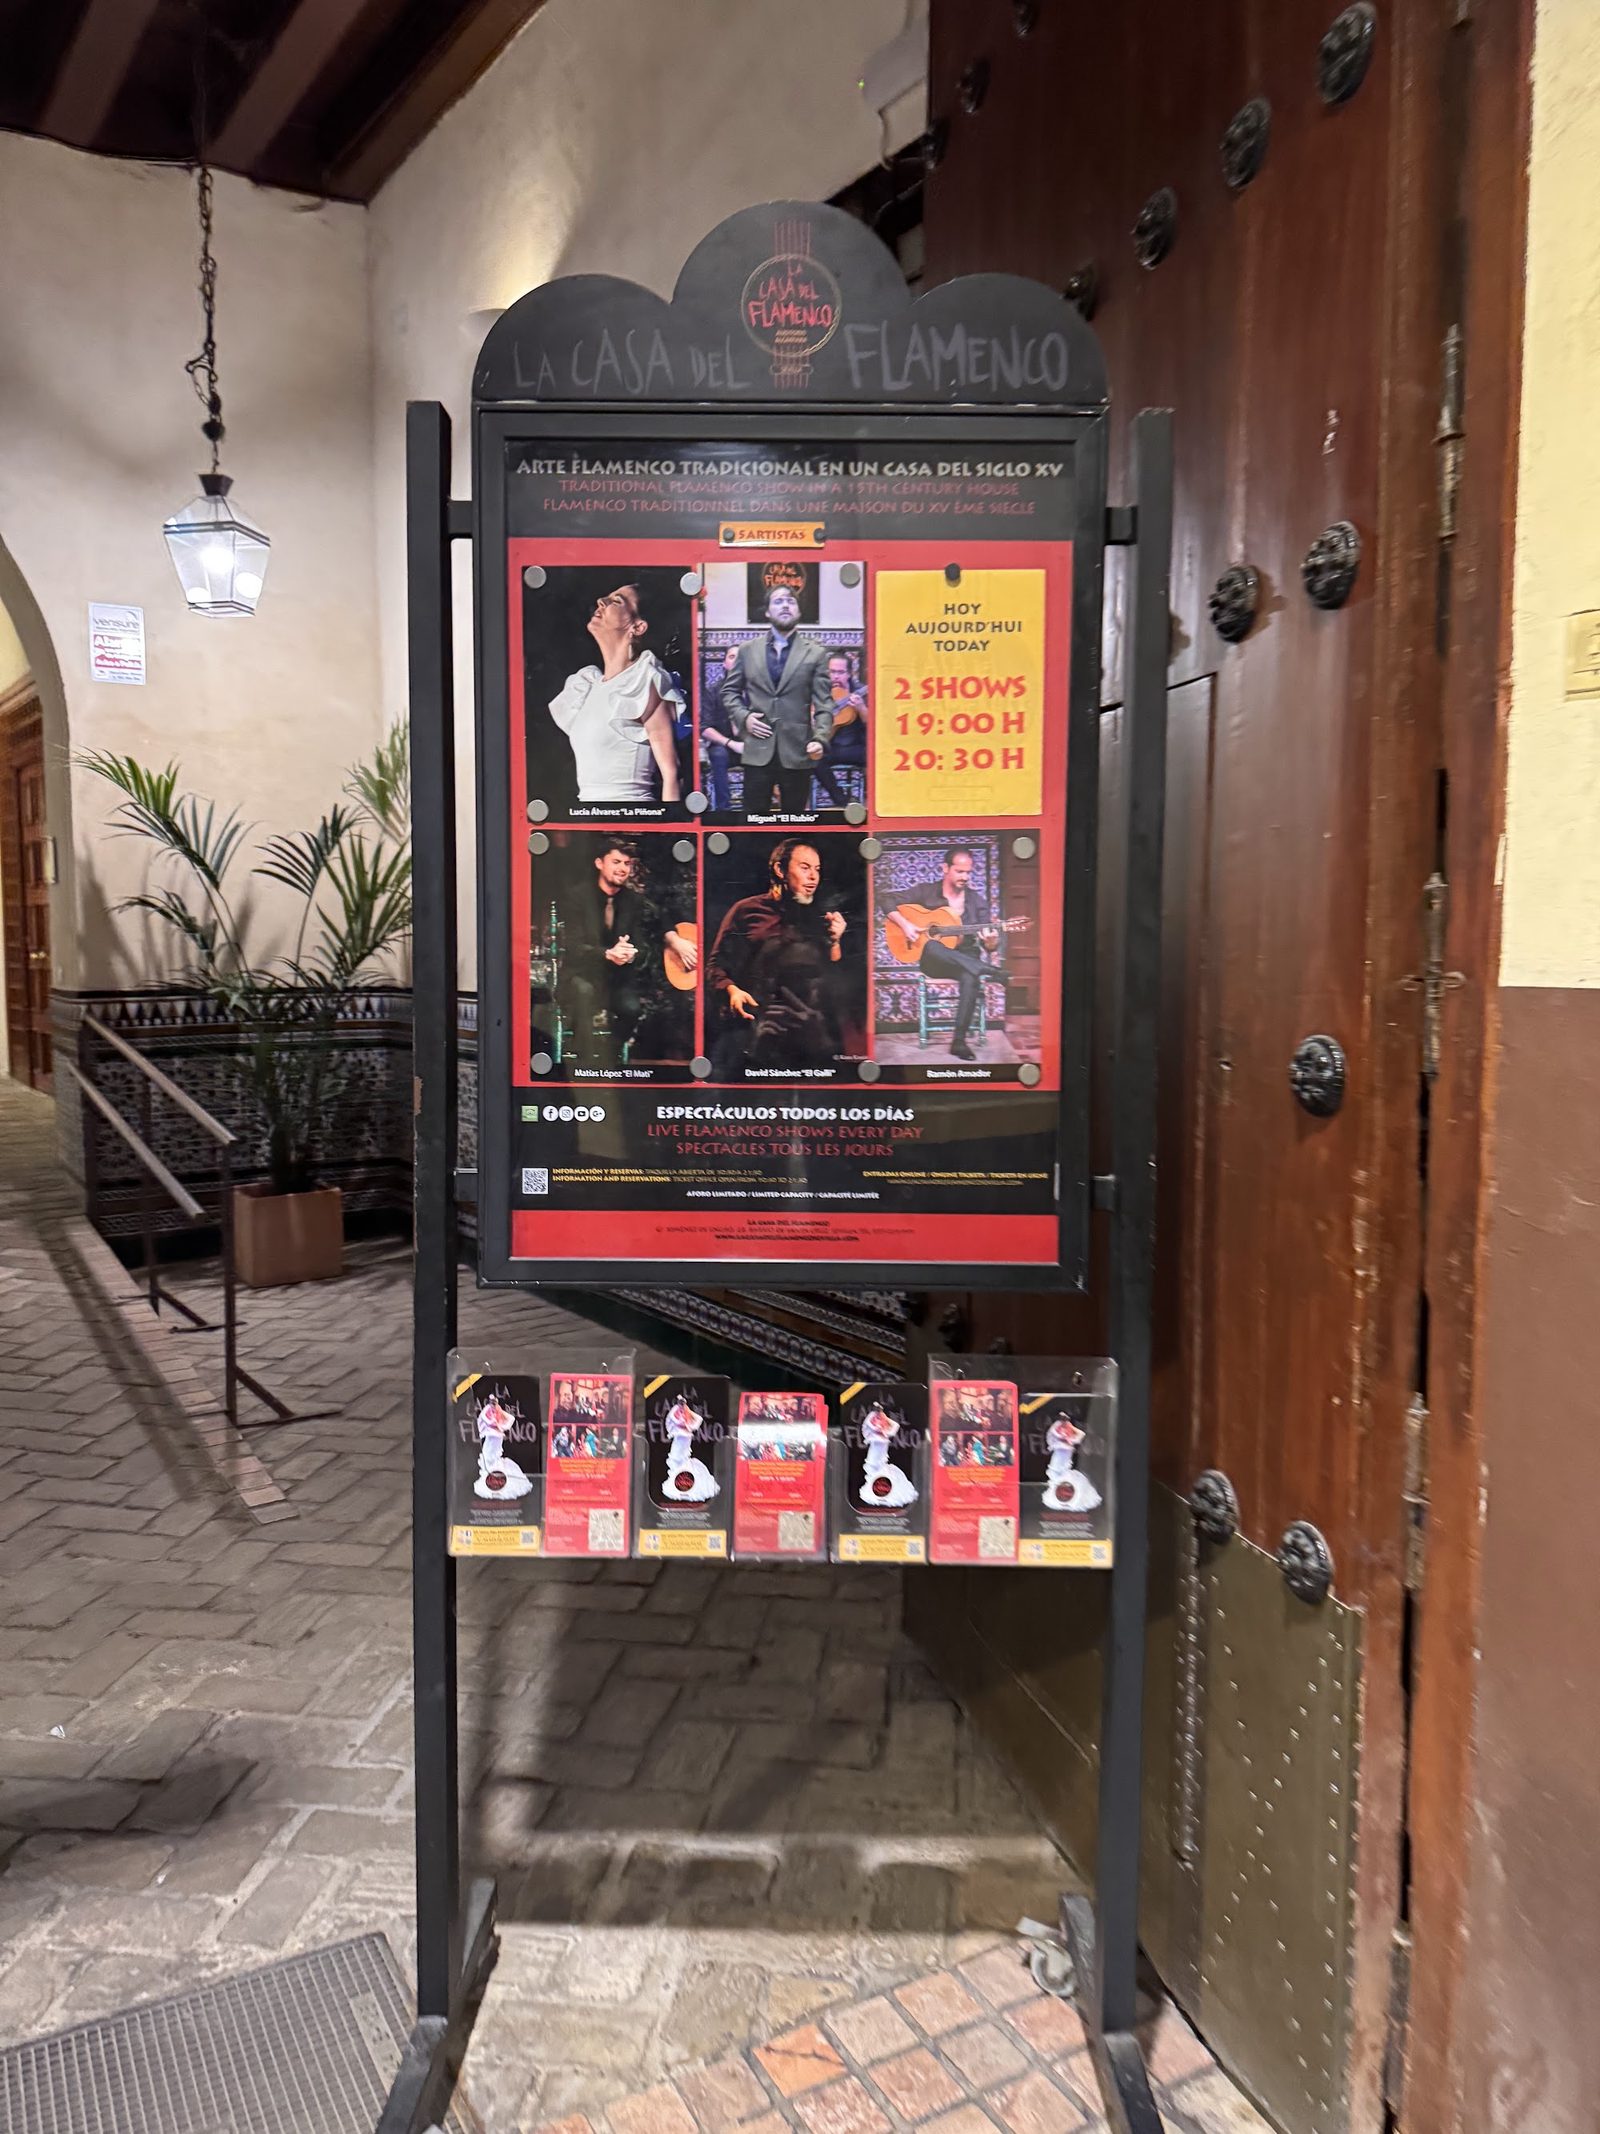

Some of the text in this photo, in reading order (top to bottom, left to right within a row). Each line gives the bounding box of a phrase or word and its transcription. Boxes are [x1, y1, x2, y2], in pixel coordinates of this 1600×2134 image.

[759, 277, 796, 300] CASA
[748, 300, 833, 328] FLAMENCO
[513, 319, 1069, 395] LA CASA DEL FLAMENCO
[516, 459, 1064, 478] ARTE FLAMENCO TRADICIONAL EN UN CASA DEL SIGLO XV
[559, 480, 663, 494] TRADITIONAL
[669, 480, 751, 494] FLAMENCO
[756, 481, 807, 495] SHOW
[831, 483, 842, 495] A
[892, 482, 962, 496] CENTURY
[967, 482, 1019, 496] HOUSE
[544, 498, 626, 512] FLAMENCO
[631, 498, 745, 513] TRADITIONNEL
[750, 500, 792, 513] DANS
[800, 500, 829, 514] UNE
[832, 500, 897, 514] MAISON
[902, 501, 924, 514] DU
[929, 501, 950, 514] XV
[943, 603, 982, 615] HOY
[906, 621, 1022, 634] AUJOURD'HUI
[934, 640, 990, 651] TODAY
[894, 676, 1027, 700] 2 SHOWS
[1002, 712, 1025, 733] H
[1002, 747, 1024, 769] H
[569, 808, 590, 816] Lucía
[591, 807, 620, 816] Álvarez
[747, 814, 777, 824] Miguel
[656, 1104, 914, 1121] ESPECTÁCULOS TODOS LOS DÍAS
[647, 1124, 924, 1139] LIVE FLAMENCO SHOWS EVERY DAY
[676, 1142, 894, 1157] SPECTACLES TOUS LES JOURS
[458, 1420, 537, 1444] FLNCO
